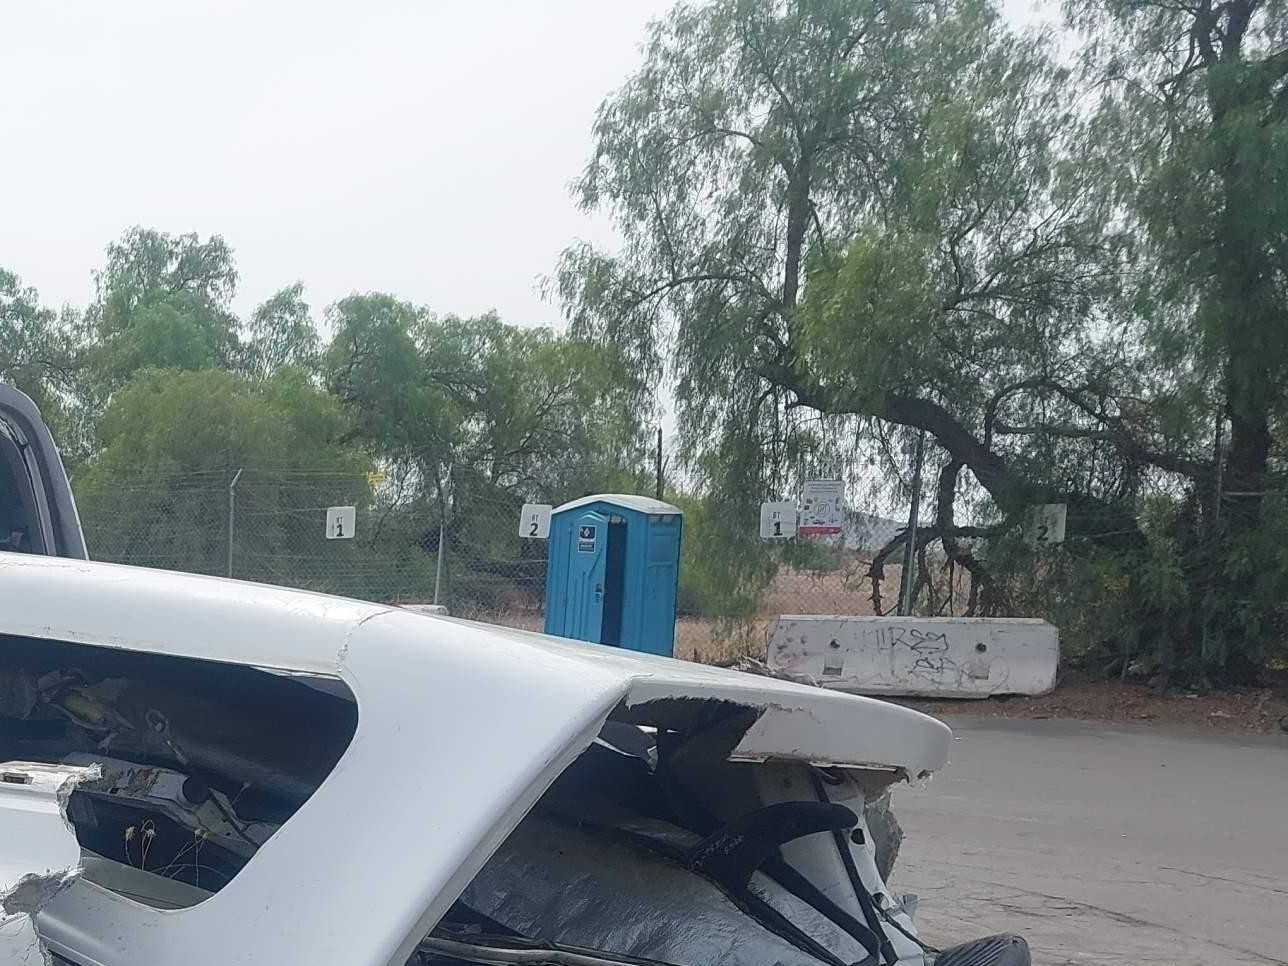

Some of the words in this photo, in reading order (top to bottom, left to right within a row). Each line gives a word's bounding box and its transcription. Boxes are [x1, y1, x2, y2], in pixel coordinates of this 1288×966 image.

[336, 524, 345, 537] 1
[529, 522, 539, 537] 2
[774, 522, 783, 536] 1
[1036, 525, 1049, 542] 2
